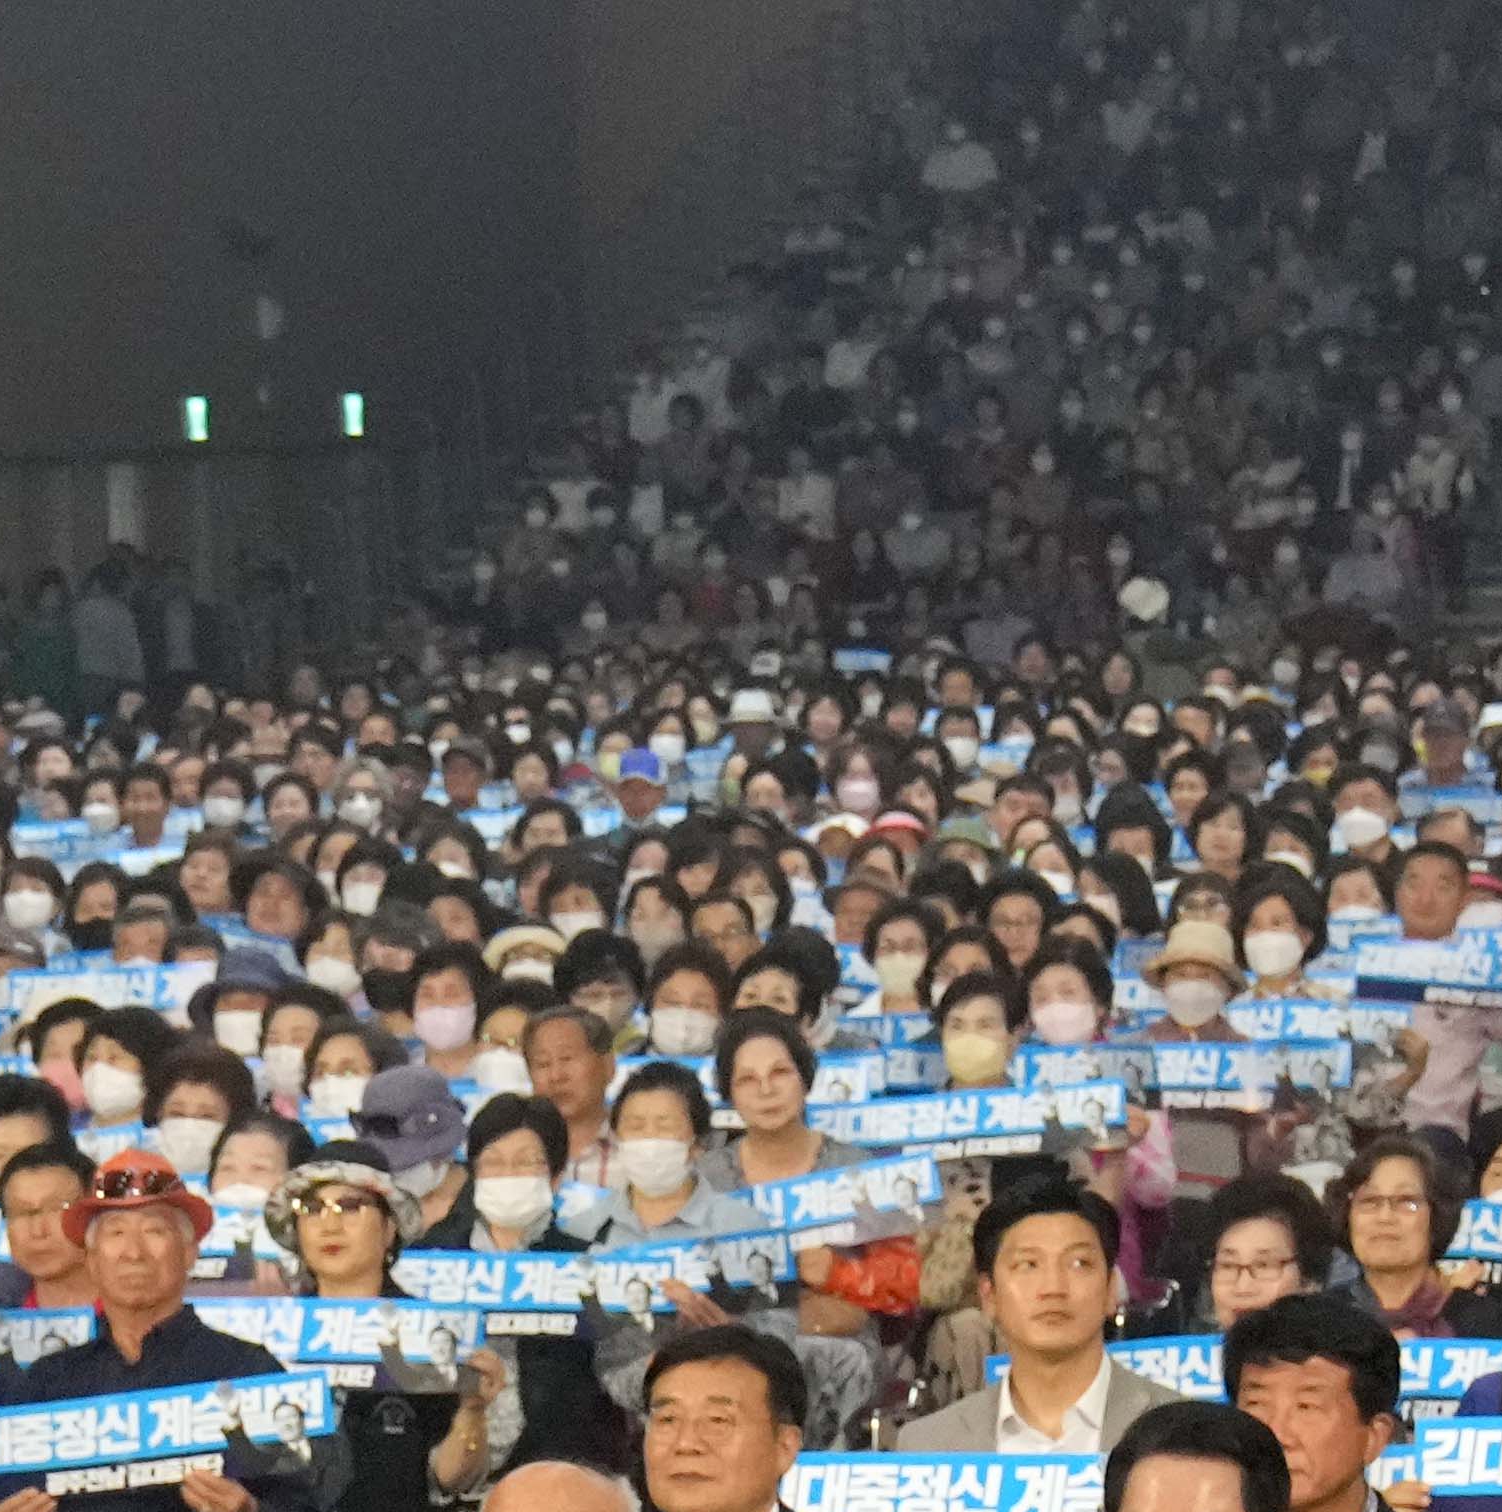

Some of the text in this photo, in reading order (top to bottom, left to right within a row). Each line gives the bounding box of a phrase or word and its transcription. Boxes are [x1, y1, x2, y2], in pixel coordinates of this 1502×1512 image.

[511, 1253, 673, 1307] 계승발전
[301, 1304, 477, 1361] 계승발전
[148, 1378, 327, 1446] 계승발전
